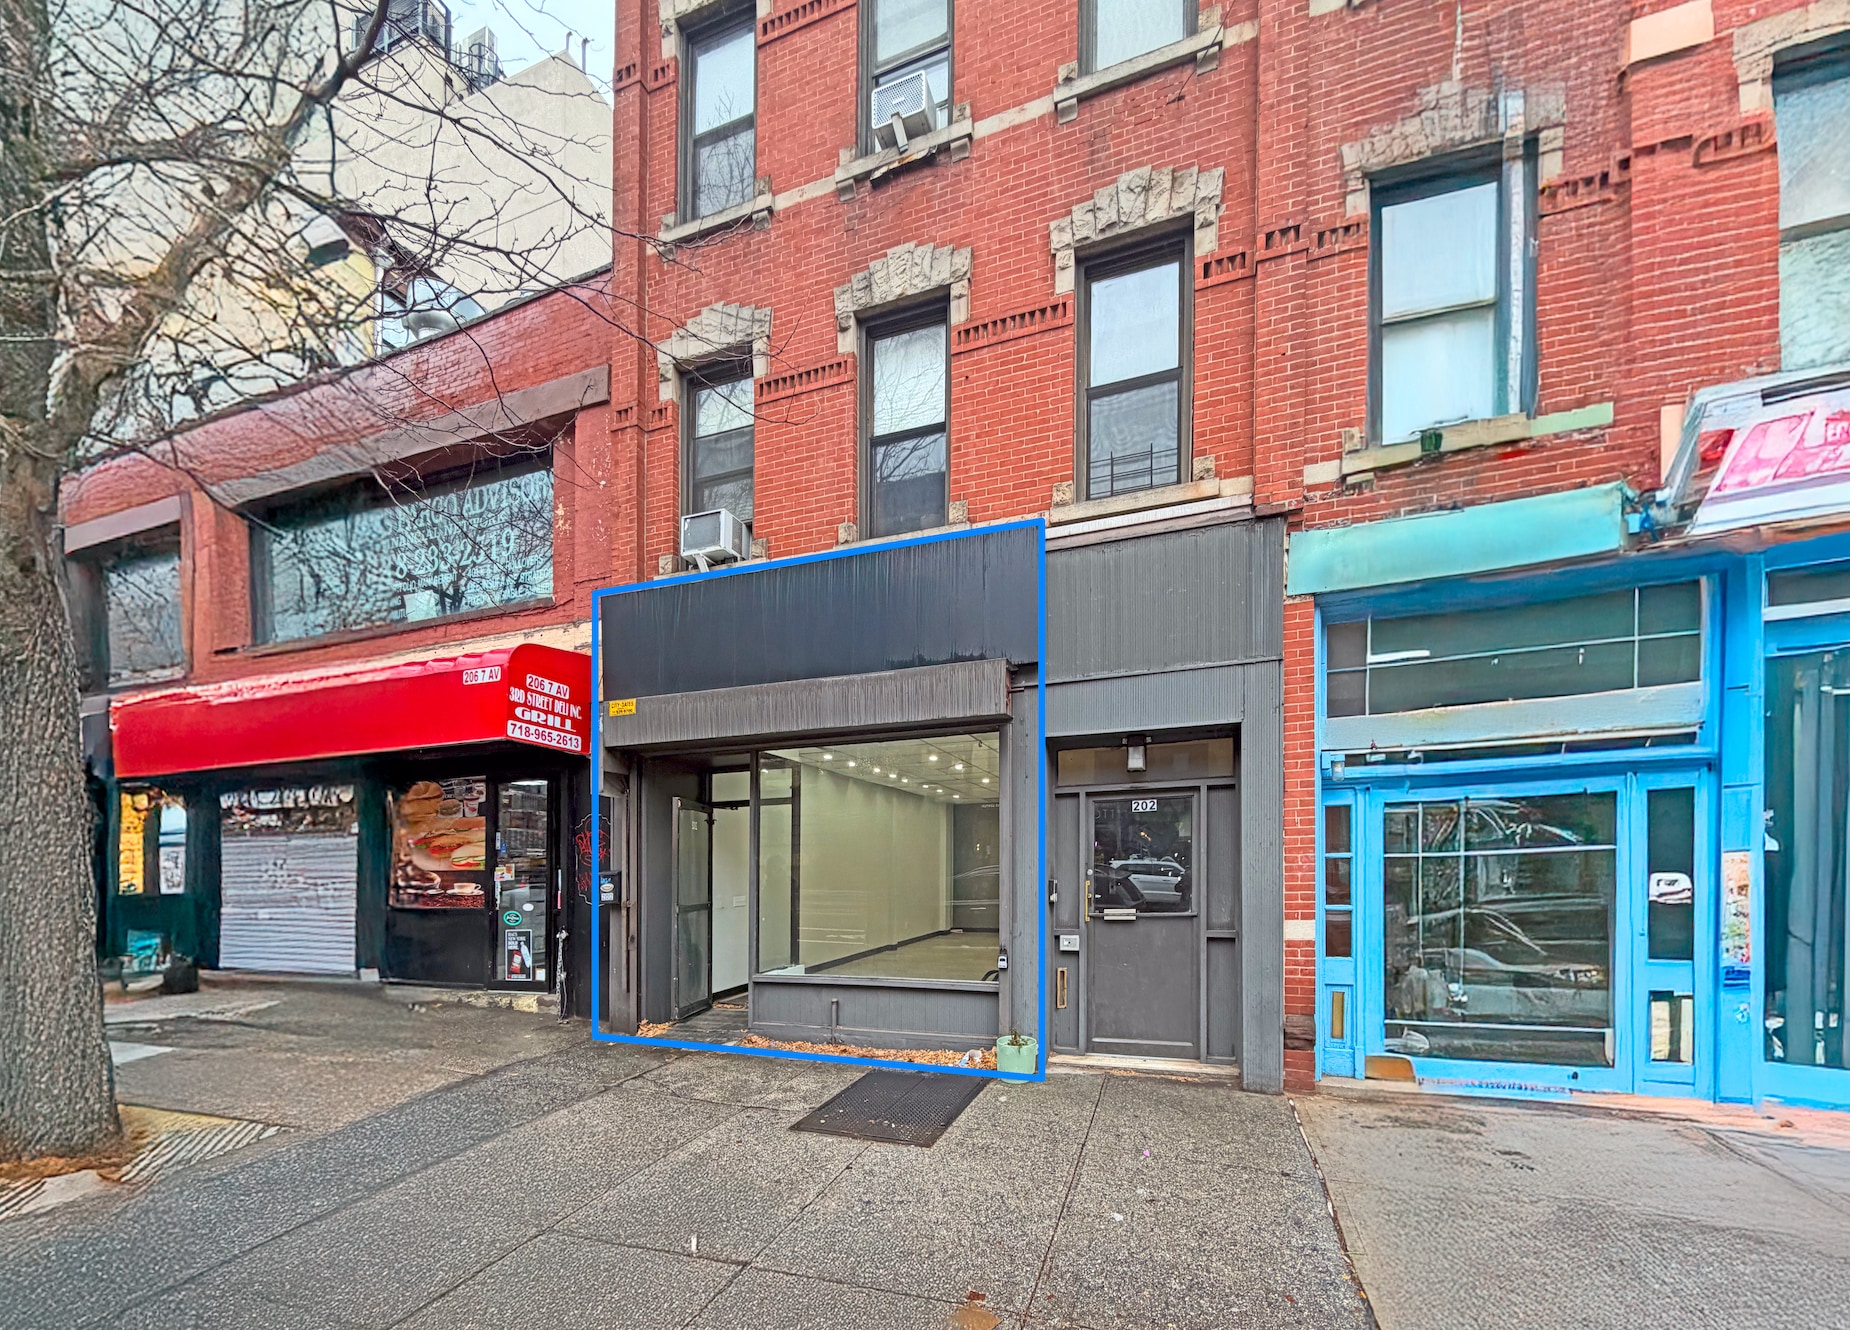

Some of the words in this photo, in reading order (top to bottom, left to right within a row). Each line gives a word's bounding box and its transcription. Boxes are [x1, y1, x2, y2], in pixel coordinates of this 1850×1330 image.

[464, 671, 479, 683] 206
[481, 670, 486, 681] 7
[488, 668, 500, 680] AV
[528, 675, 545, 691] 206
[548, 682, 553, 693] 7
[555, 685, 568, 698] AV
[509, 686, 525, 703] 3RD
[526, 692, 553, 711] STREET
[554, 700, 569, 715] DELI
[514, 706, 576, 732] GRILL
[510, 723, 579, 749] 718-965-2613
[1133, 801, 1156, 811] 202
